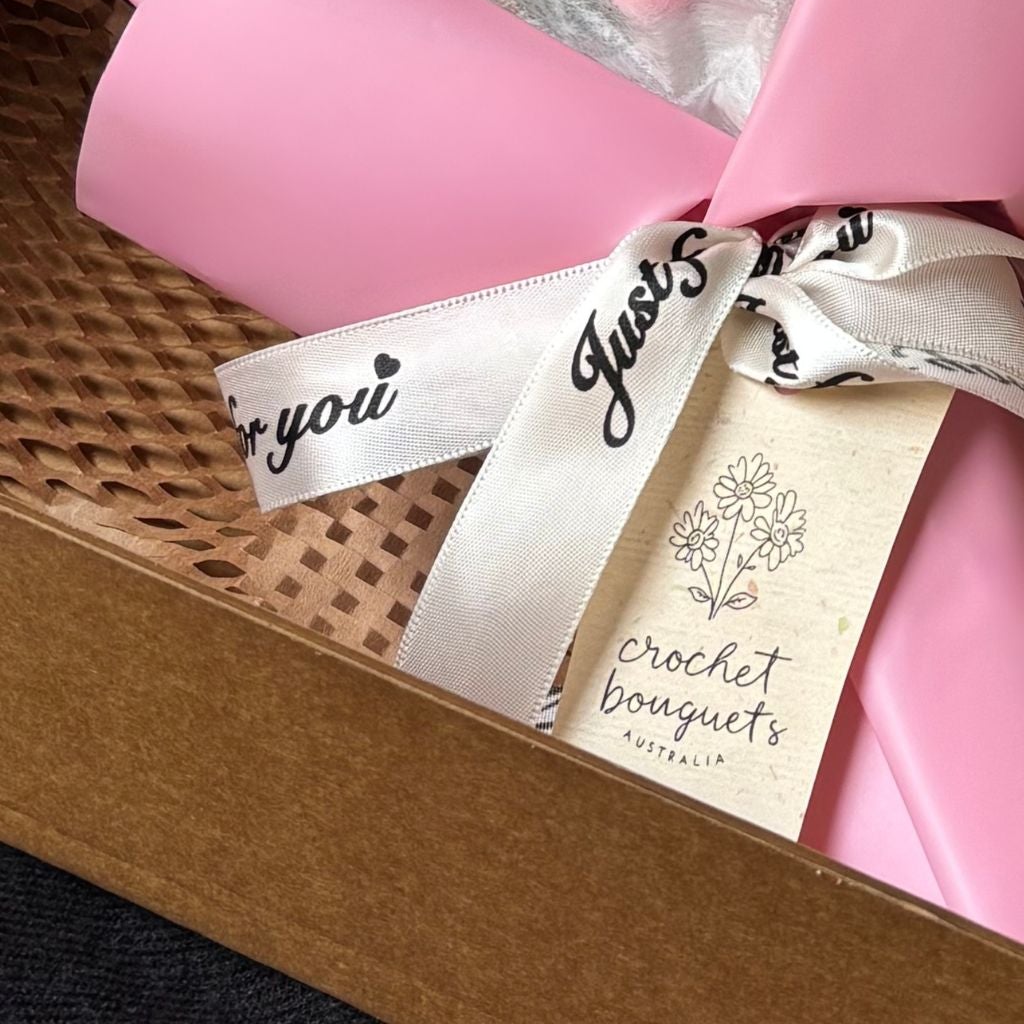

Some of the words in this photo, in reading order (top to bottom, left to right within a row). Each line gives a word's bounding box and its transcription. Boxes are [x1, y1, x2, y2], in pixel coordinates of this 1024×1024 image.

[571, 258, 674, 448] Just
[266, 379, 399, 475] you
[618, 635, 792, 694] crochet
[623, 729, 725, 767] AUSTRALIA
